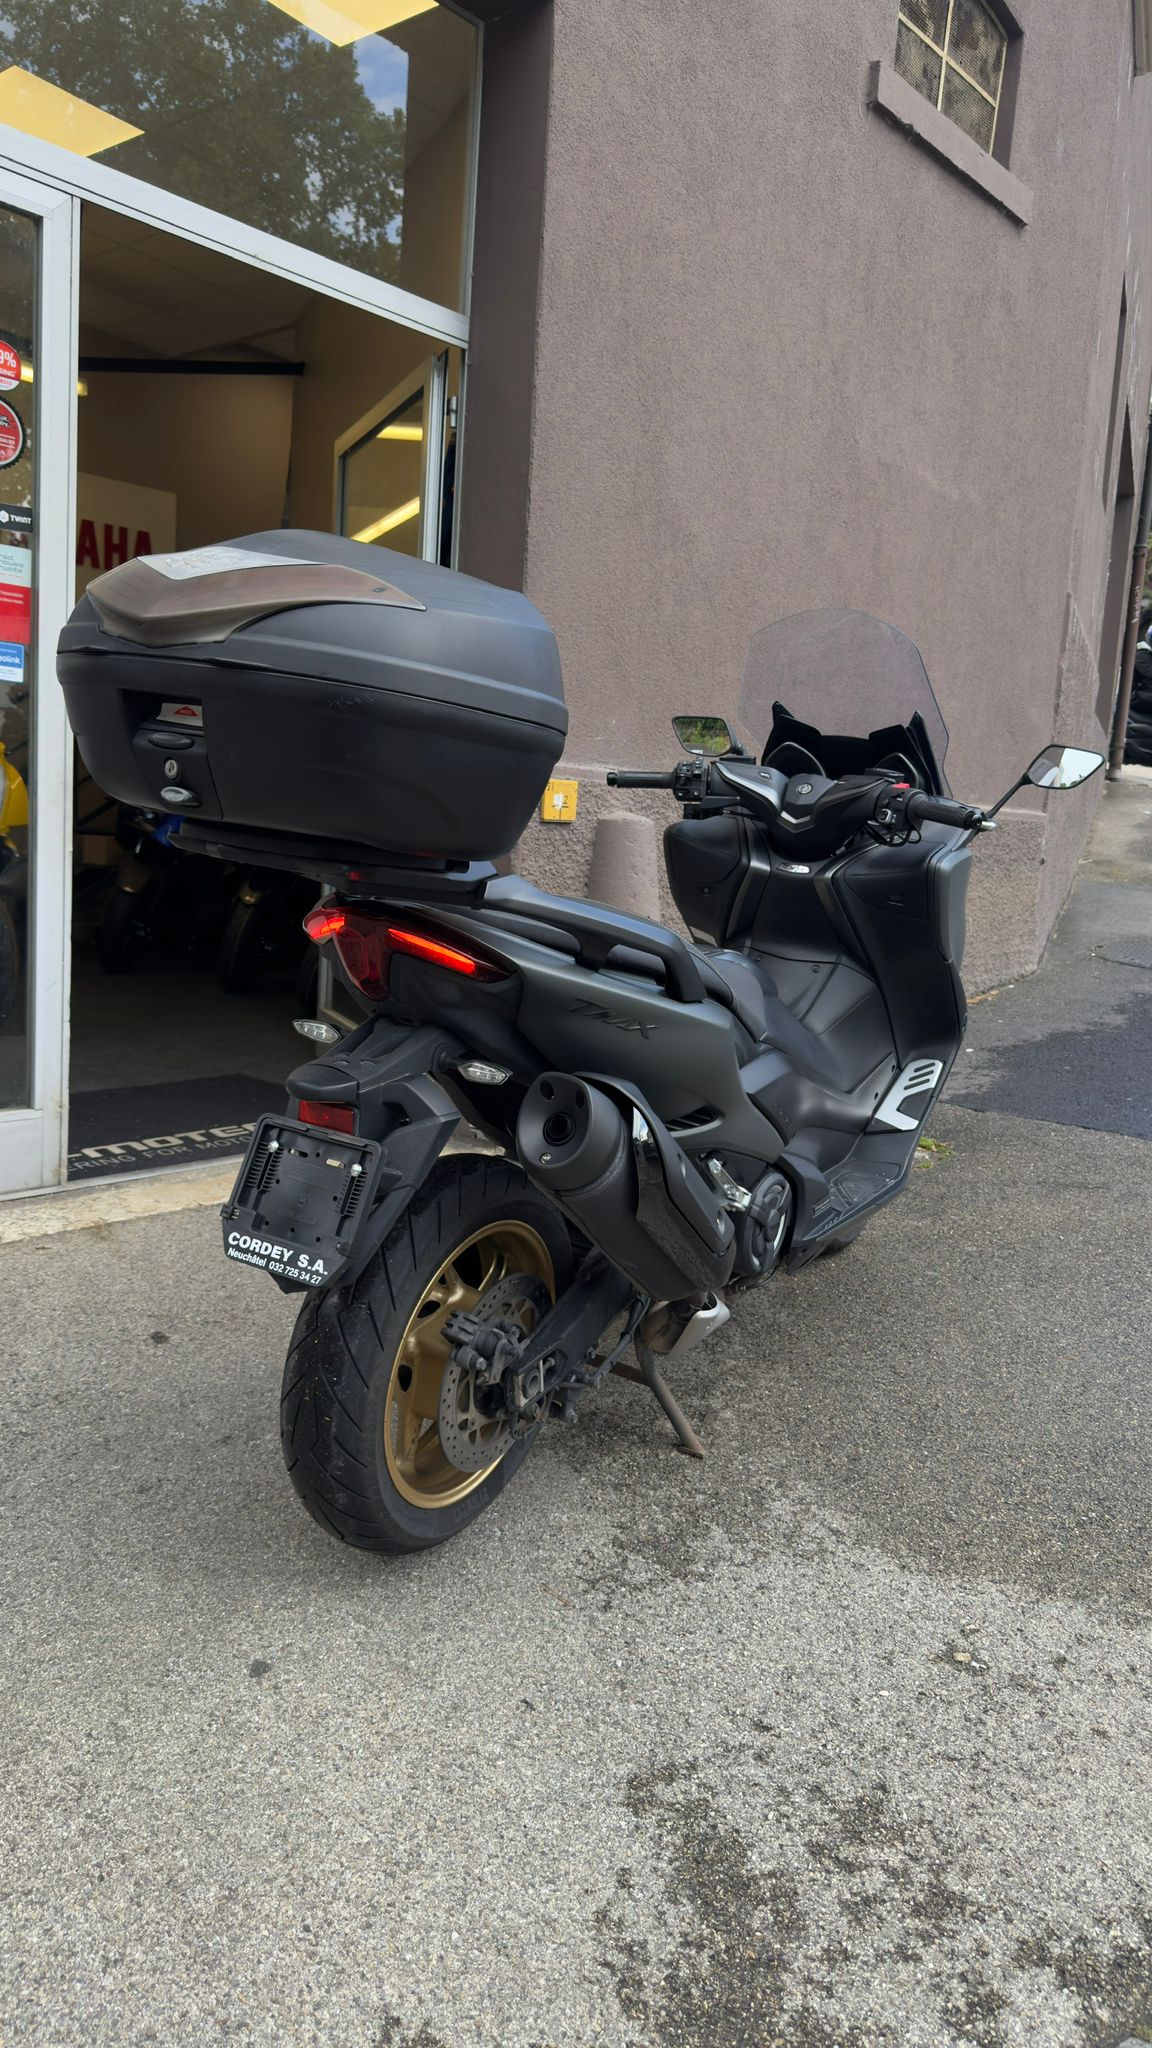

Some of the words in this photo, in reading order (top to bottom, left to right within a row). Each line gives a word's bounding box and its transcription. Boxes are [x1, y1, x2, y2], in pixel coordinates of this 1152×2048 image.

[144, 1145, 193, 1159] FOR
[227, 1247, 267, 1267] Neuchâtel
[268, 1260, 284, 1273] 032
[284, 1266, 300, 1278] 725
[299, 1272, 311, 1281] 34
[310, 1274, 322, 1285] 27
[228, 1231, 294, 1262] CORDEY
[297, 1253, 328, 1275] S.A.
